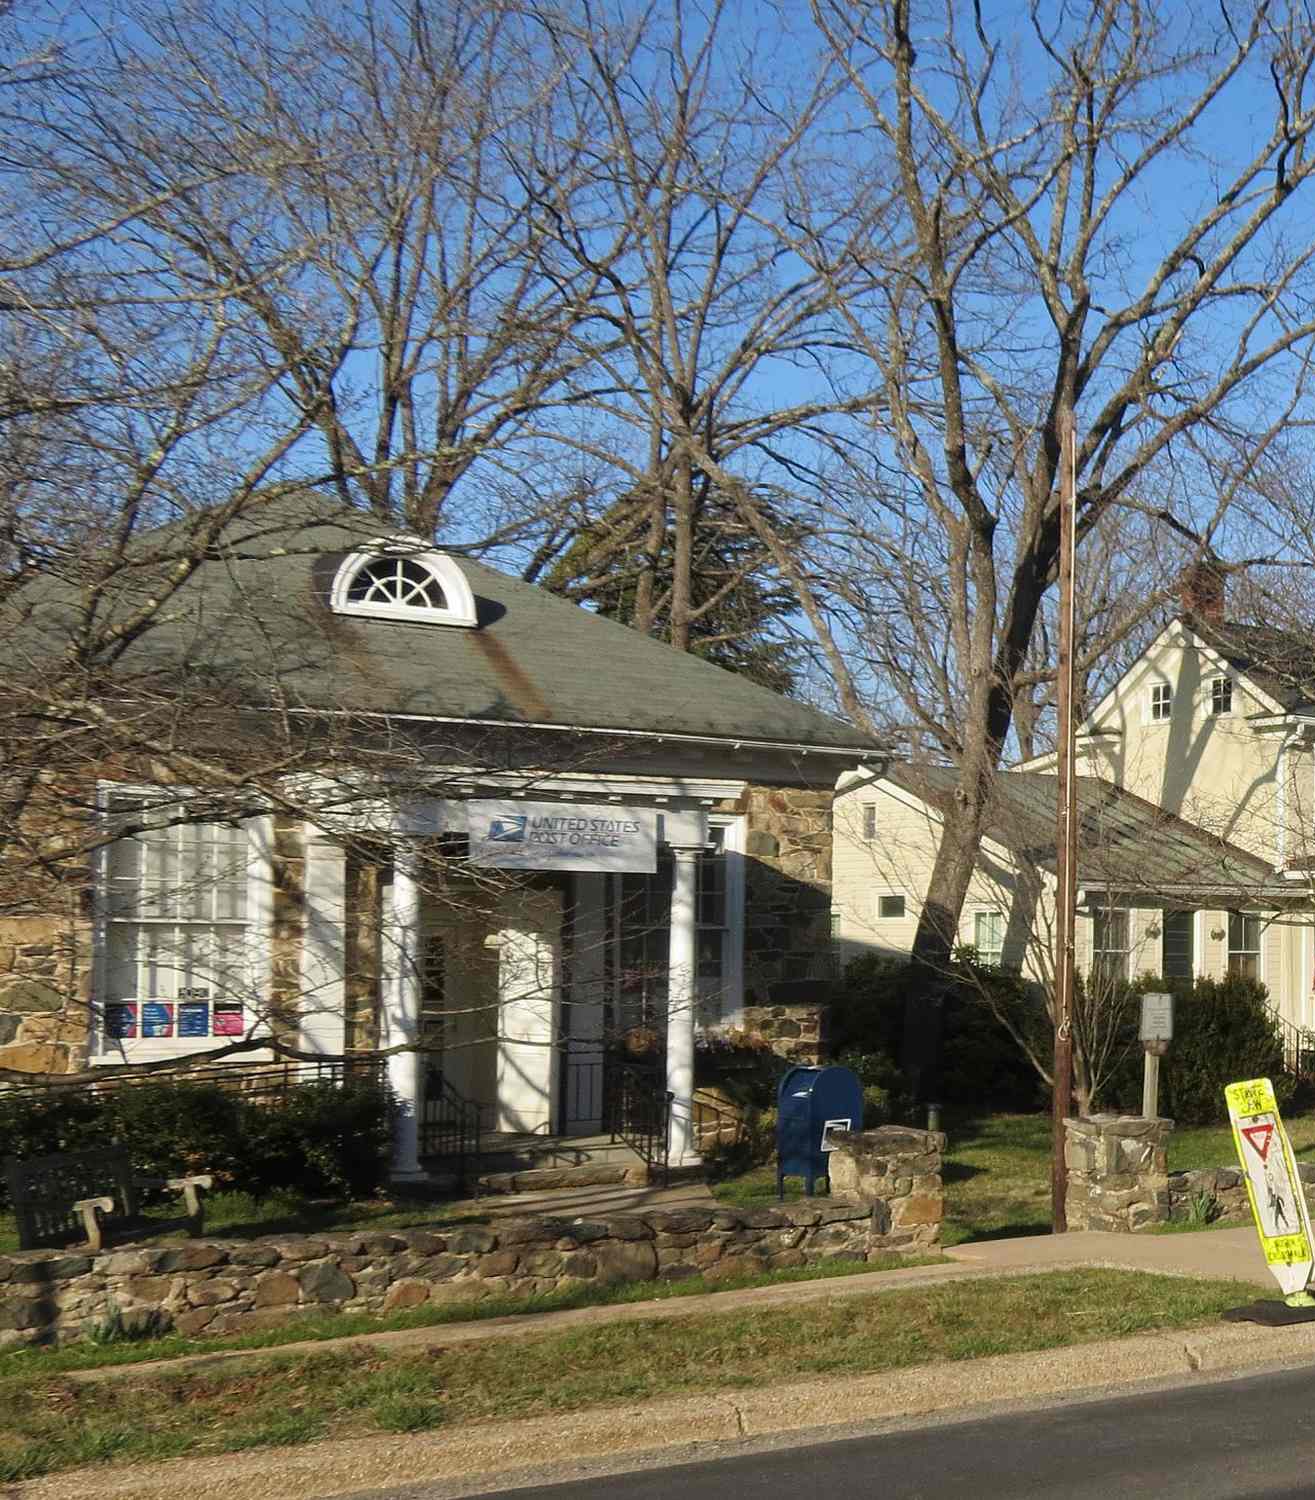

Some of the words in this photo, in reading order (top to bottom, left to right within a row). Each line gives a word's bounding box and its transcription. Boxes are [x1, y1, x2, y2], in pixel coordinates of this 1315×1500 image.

[531, 816, 588, 831] UNITED
[589, 818, 640, 833] STATES
[529, 831, 568, 845] POST
[568, 832, 621, 848] OFFICE
